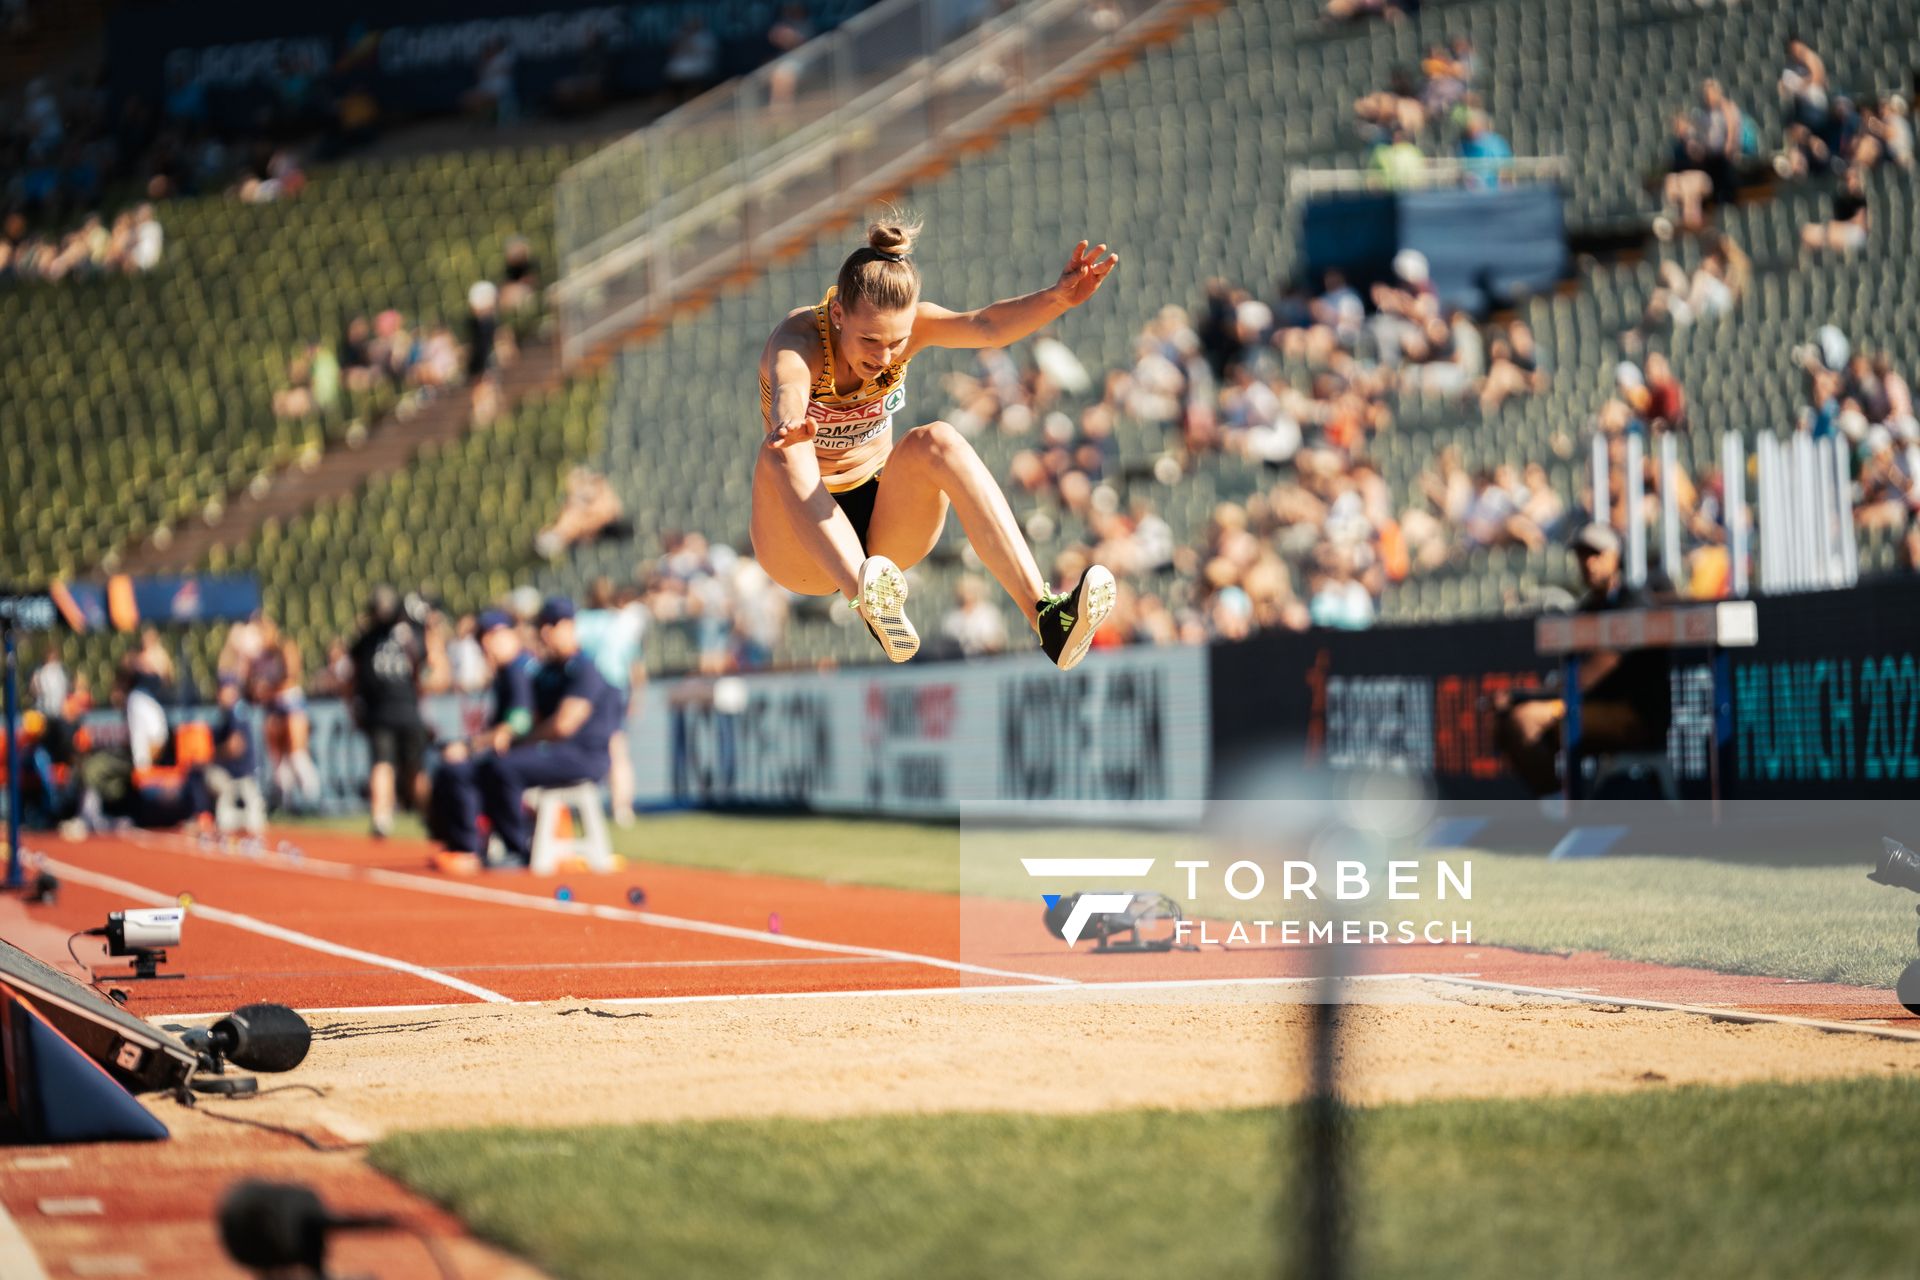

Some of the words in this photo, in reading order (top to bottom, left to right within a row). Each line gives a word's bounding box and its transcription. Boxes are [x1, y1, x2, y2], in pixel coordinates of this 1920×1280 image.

[807, 402, 881, 423] SPAR
[813, 437, 855, 449] UNICH
[1735, 657, 1856, 781] MUNICH
[1860, 652, 1920, 780] 202
